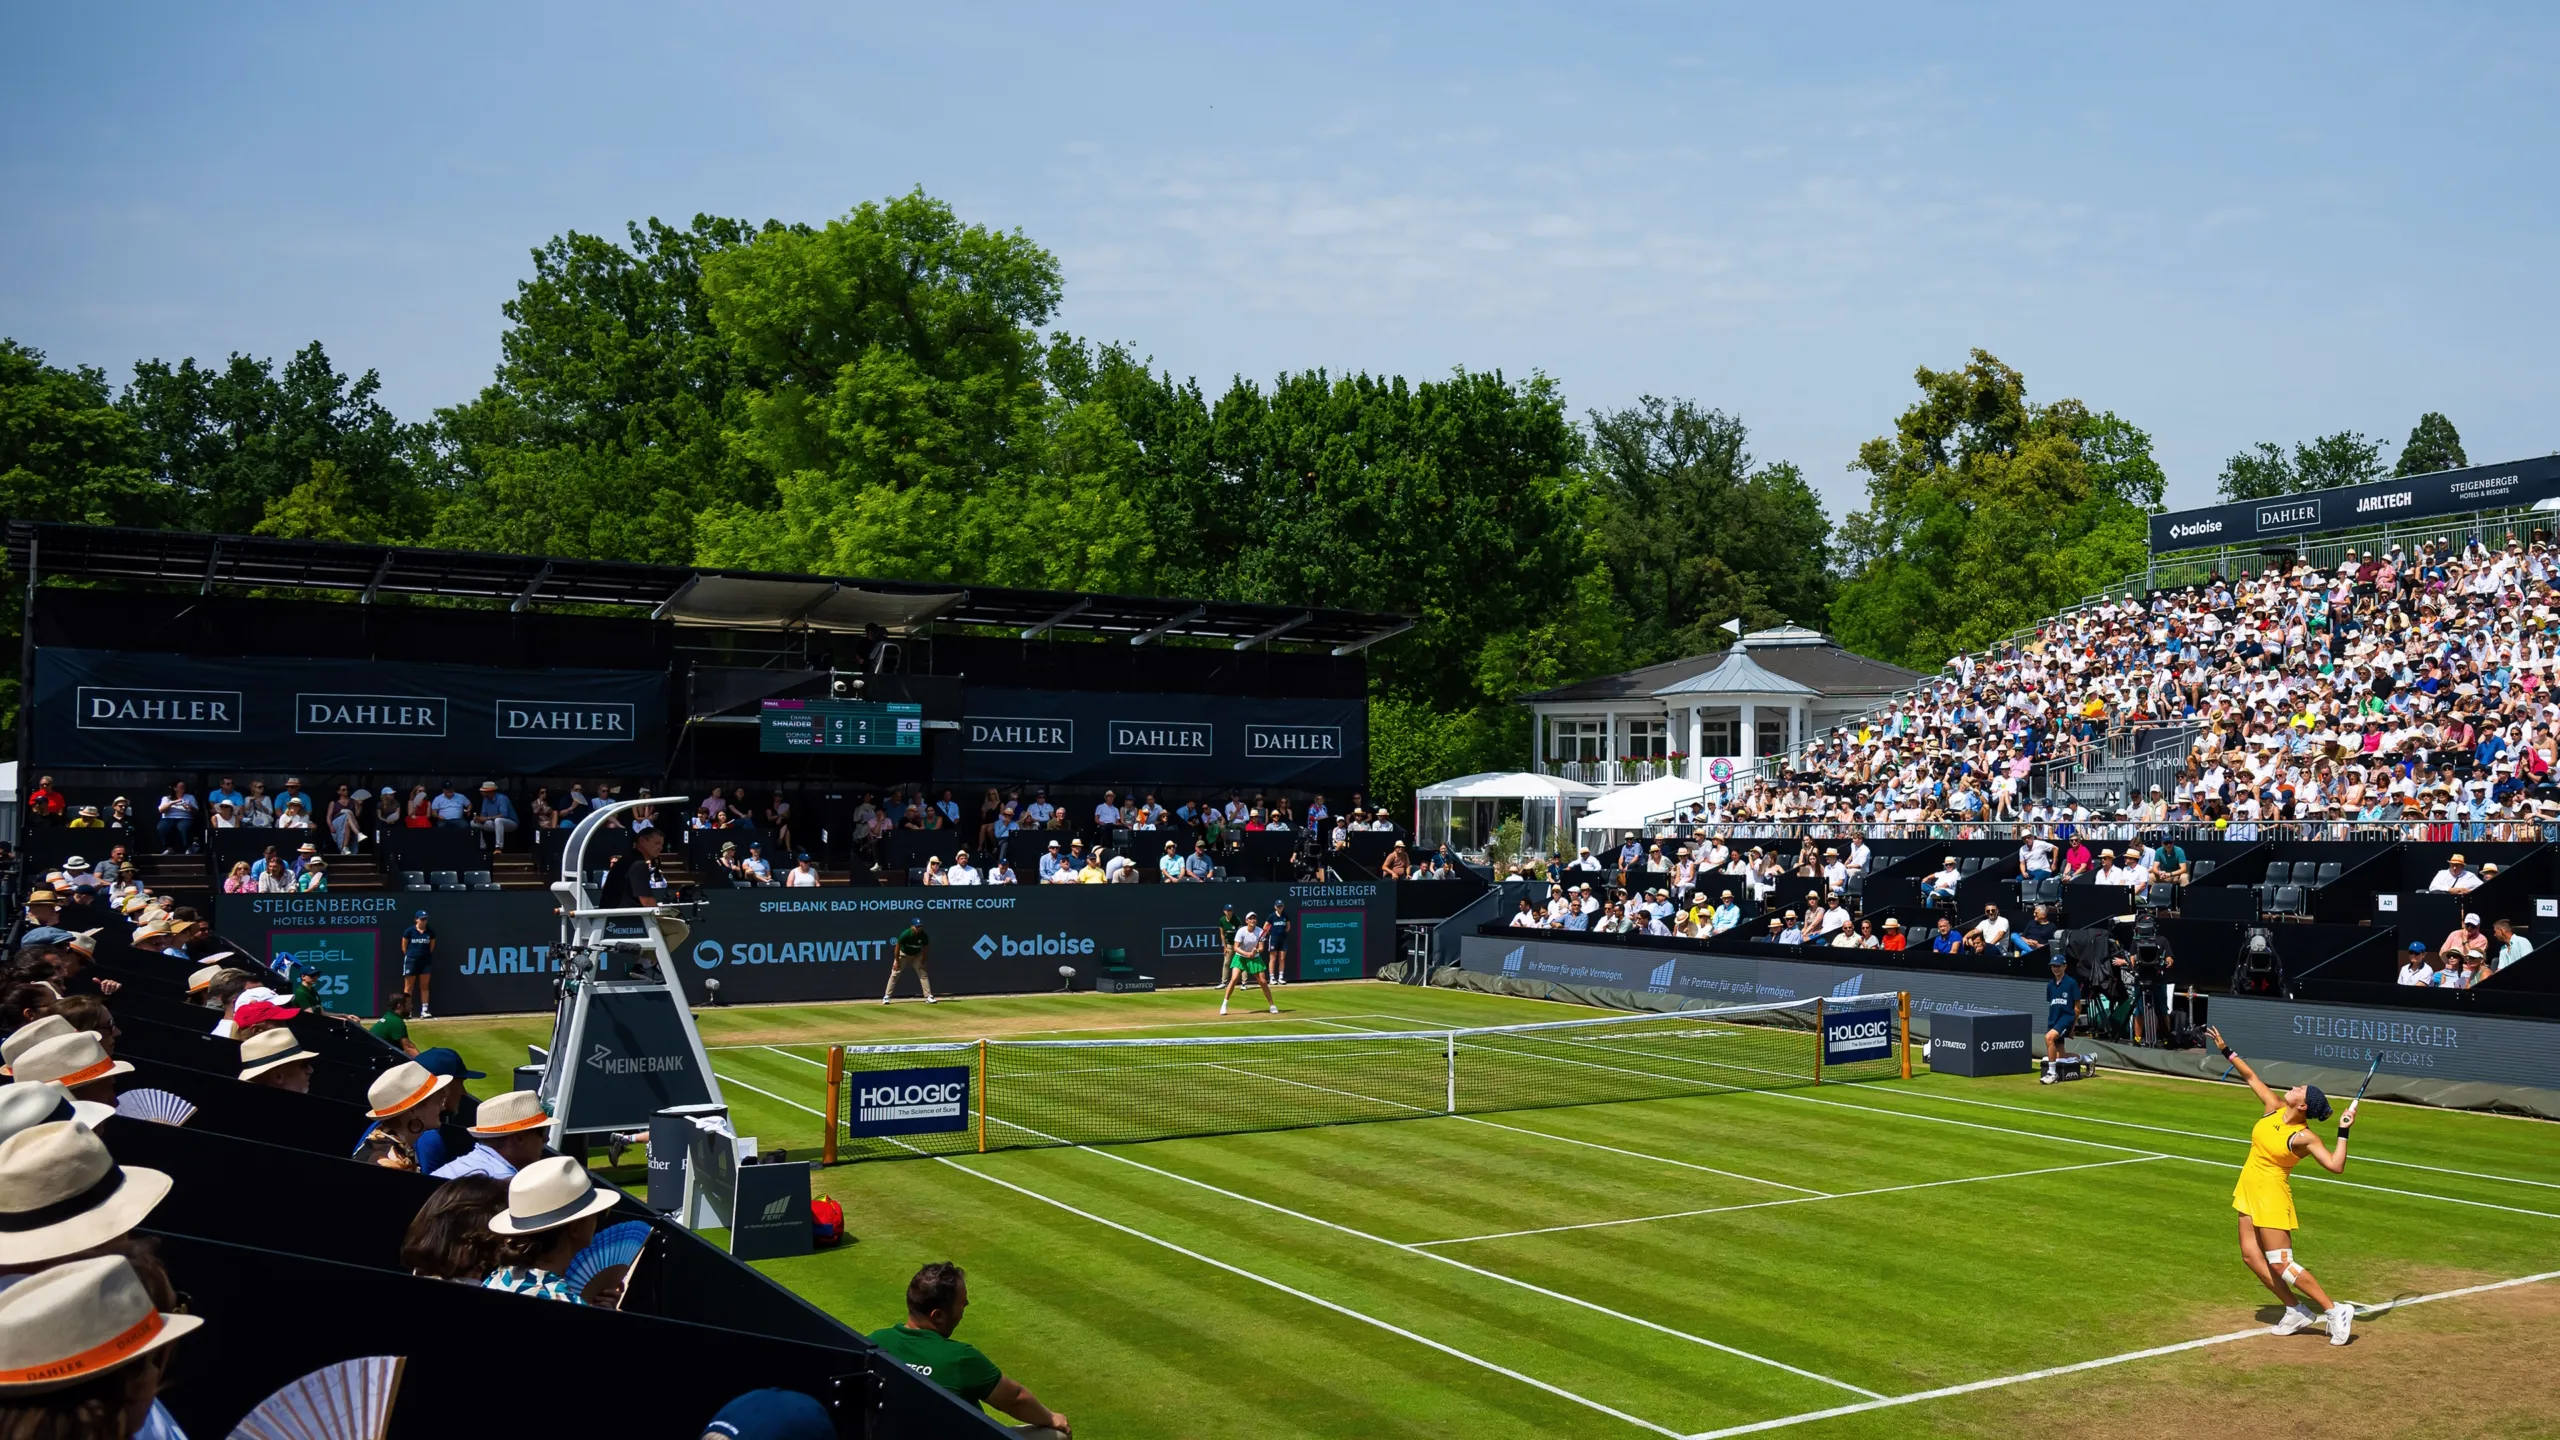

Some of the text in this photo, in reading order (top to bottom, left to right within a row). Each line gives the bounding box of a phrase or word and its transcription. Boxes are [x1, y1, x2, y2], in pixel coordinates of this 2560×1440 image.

[2450, 475, 2519, 493] STEIGENBERGER
[2460, 491, 2479, 499] HOTELS
[2486, 487, 2510, 496] RESORTS
[2356, 491, 2412, 513] JARLTECH
[2262, 506, 2315, 525] DAHLER
[2181, 519, 2223, 537] baloise
[91, 698, 230, 721] DAHLER
[309, 704, 436, 727] DAHLER
[508, 710, 625, 732] DAHLER
[835, 720, 843, 729] 6
[859, 720, 866, 729] 2
[835, 735, 842, 743] 3
[859, 735, 866, 743] 5
[972, 726, 1065, 744] DAHLER
[1118, 729, 1205, 748] DAHLER
[1253, 733, 1335, 750] DAHLER
[1289, 885, 1377, 896] STEIGENBERGER
[252, 898, 397, 913] STEIGENBERGER
[759, 898, 1016, 912] SPIELBANK BAD HOMBURG CENTRE COURT
[1302, 899, 1327, 907] HOTELS
[1336, 898, 1365, 906] RESORTS
[273, 915, 378, 926] HOTELS & RESORTS
[1002, 931, 1095, 957] baloise
[1169, 934, 1224, 948] DAHL
[1318, 938, 1346, 954] 153
[460, 945, 607, 975] JARLT
[1538, 962, 1560, 973] Partner
[1560, 965, 1570, 975] für
[1570, 967, 1588, 977] große
[1125, 981, 1154, 989] STRATECO
[1680, 975, 1690, 986] Ihr
[1691, 977, 1718, 989] Partner
[1719, 979, 1731, 992] für
[1731, 981, 1753, 994] große
[2293, 1015, 2459, 1048] STEIGENBERGER
[1942, 1040, 1966, 1050] STRATECO
[1991, 1040, 2024, 1050] STRATECO
[2314, 1044, 2360, 1061] HOTELS
[2364, 1048, 2373, 1061] &
[26, 1360, 85, 1382] DAHLER
